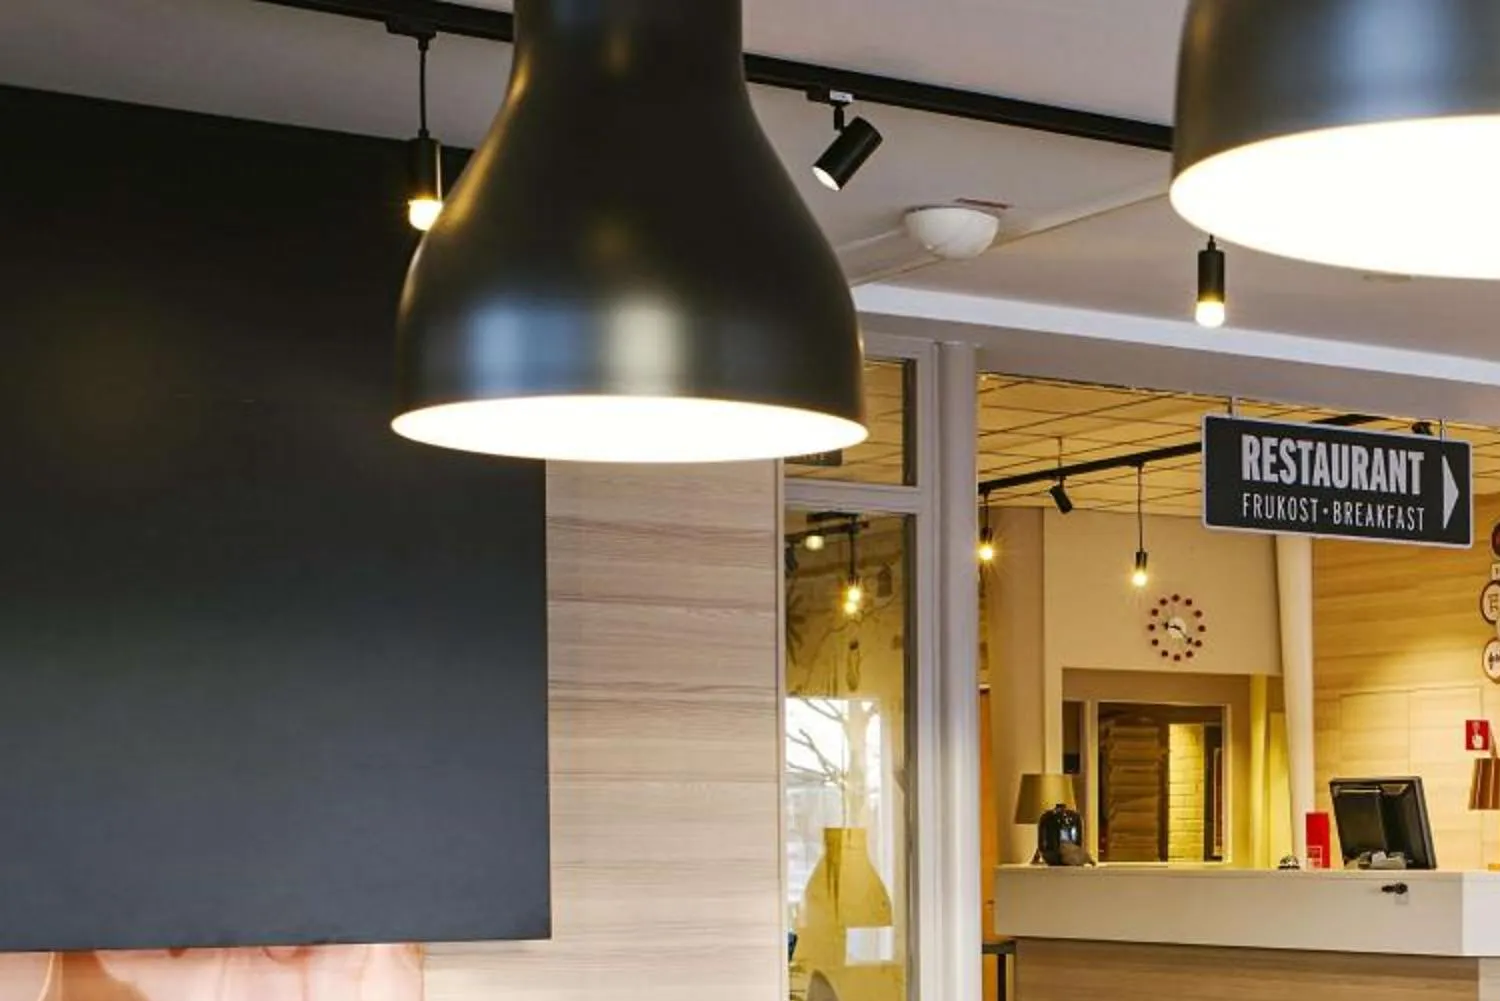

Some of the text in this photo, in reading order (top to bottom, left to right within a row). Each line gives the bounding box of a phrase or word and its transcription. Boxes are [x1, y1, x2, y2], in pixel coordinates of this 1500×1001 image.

[1241, 433, 1424, 495] RESTAURANT
[1242, 492, 1425, 532] FRUKOST BREAKFAST
